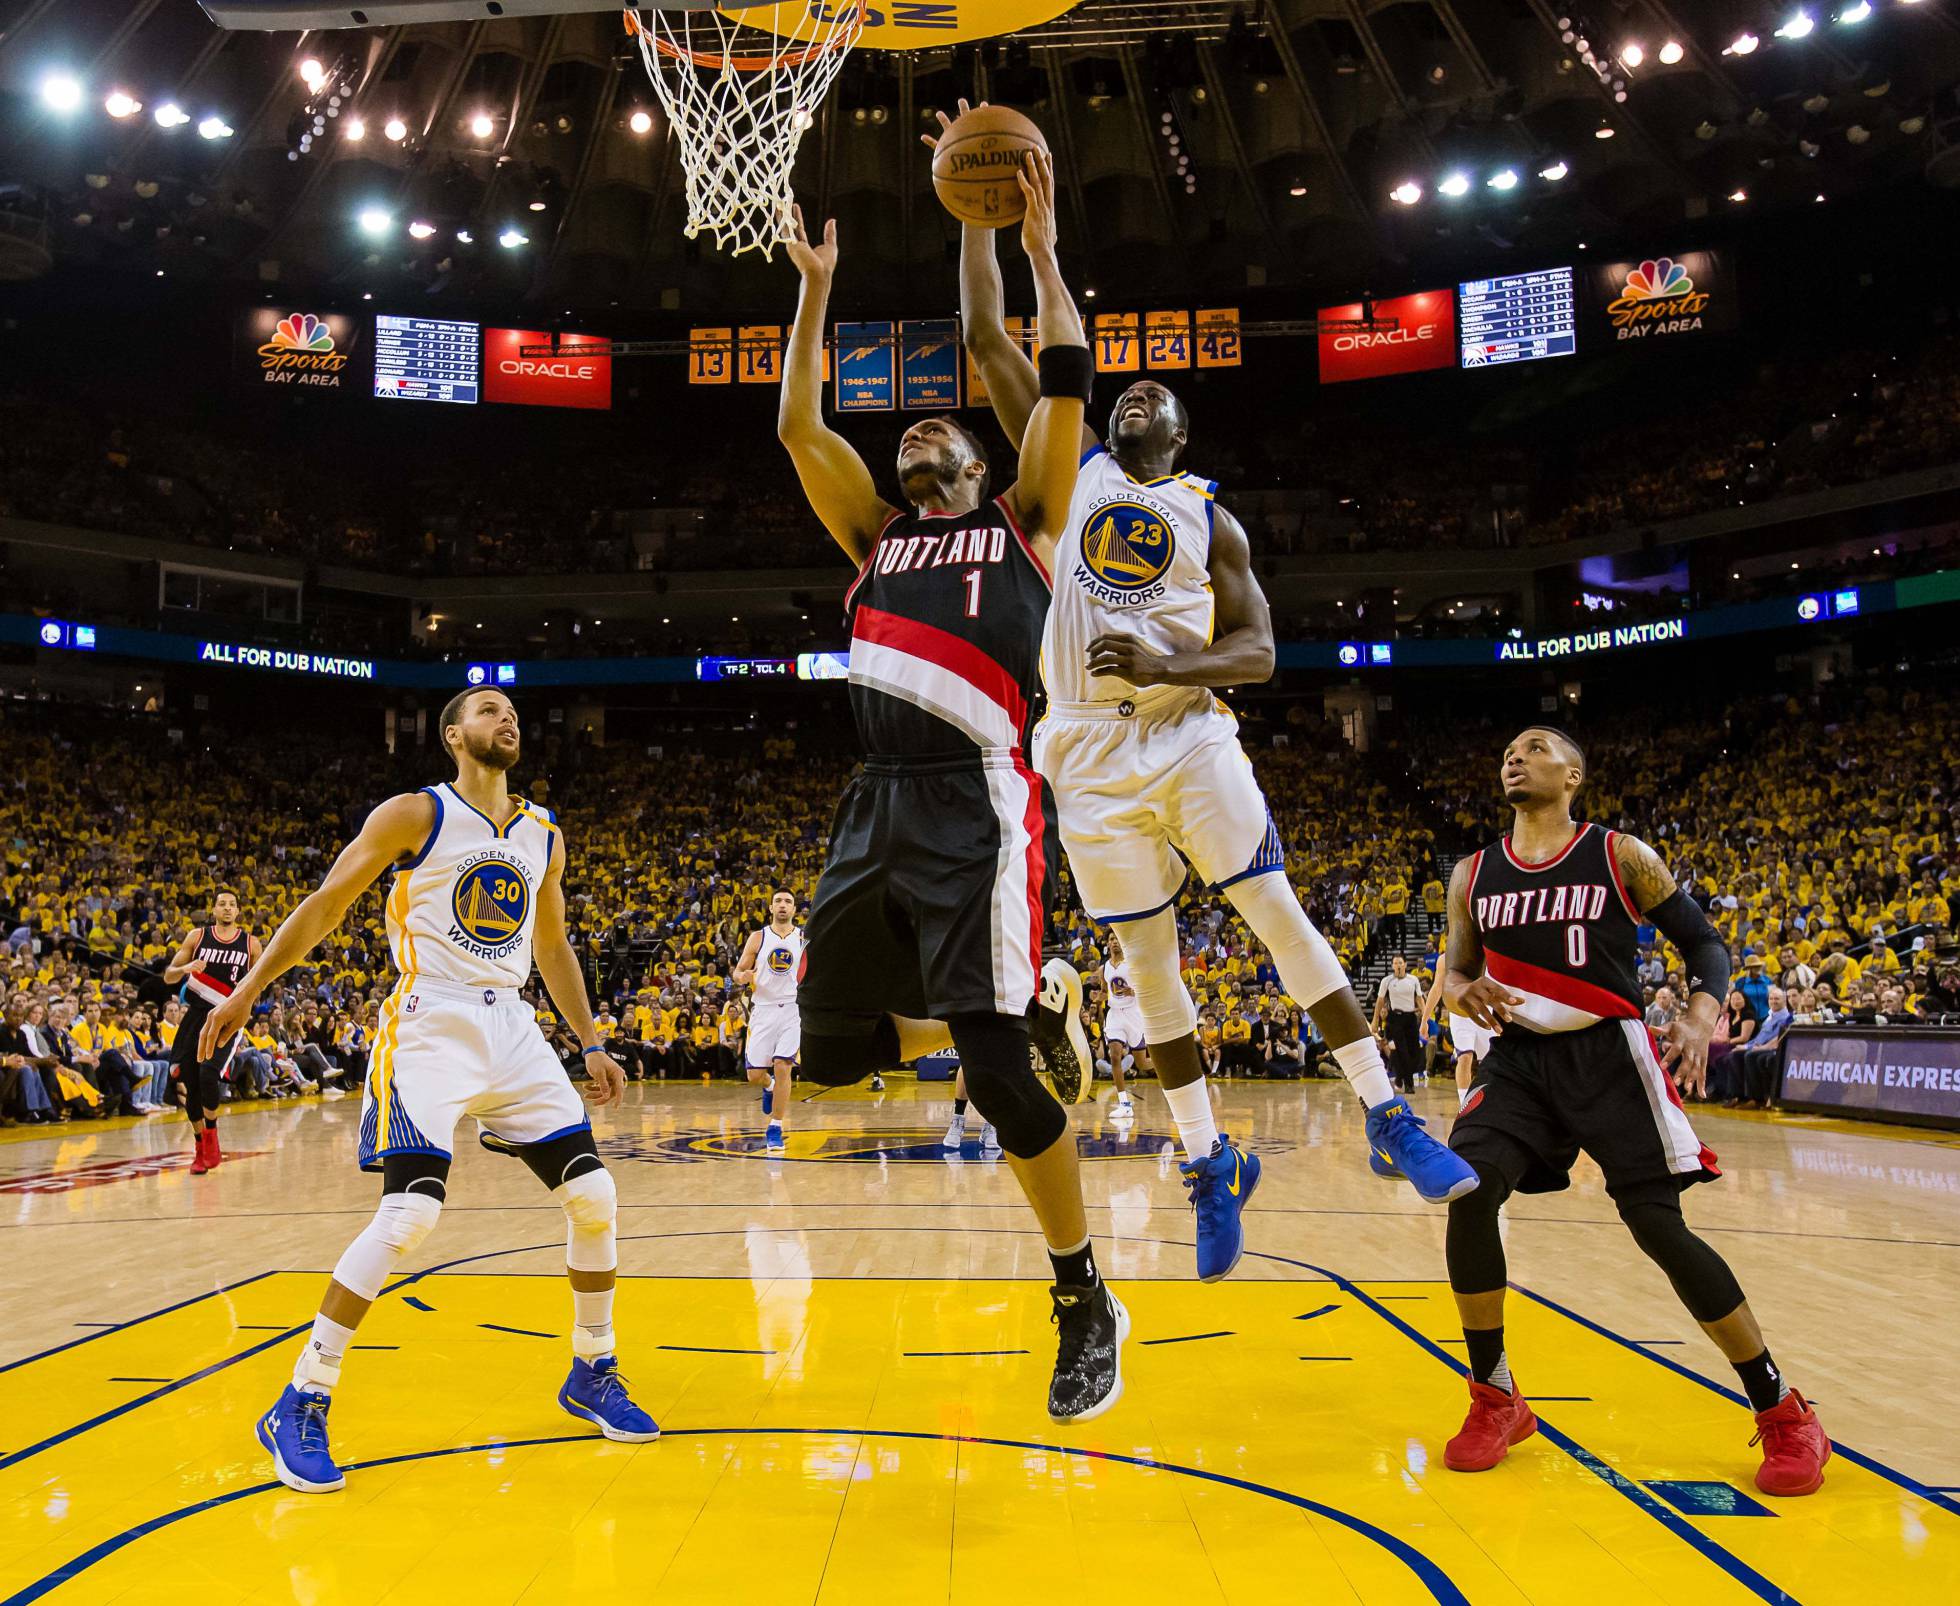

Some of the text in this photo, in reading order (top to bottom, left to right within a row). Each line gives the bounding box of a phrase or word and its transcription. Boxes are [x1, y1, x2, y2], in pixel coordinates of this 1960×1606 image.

[1607, 291, 1709, 328] Sports
[1334, 324, 1433, 351] ORACLE
[1617, 317, 1702, 340] BAY AREA
[257, 343, 347, 371] Sports
[1102, 335, 1131, 364] 17
[1150, 334, 1186, 362] 24
[1201, 331, 1238, 359] 42
[500, 360, 592, 379] ORACLE
[697, 347, 724, 377] 13
[746, 346, 774, 376] 14
[265, 371, 340, 387] BAY AREA
[843, 377, 888, 385] 1946-1947
[843, 399, 888, 407] CHAMPIONS
[1088, 493, 1145, 510] GOLDEN
[1128, 520, 1163, 546] 23
[874, 527, 1006, 580] PORTLAND
[963, 568, 983, 617] 1
[1073, 564, 1165, 605] WARRIORS
[1500, 619, 1682, 659] ALL FOR DUB NATION
[202, 643, 372, 678] ALL FOR DUB NATION
[456, 850, 535, 886] GOLDEN STATE
[493, 879, 520, 903] 30
[1477, 885, 1607, 933] PORTLAND
[447, 924, 523, 960] WARRIORS
[1567, 924, 1587, 966] 0
[199, 947, 248, 967] PORTLAND
[230, 965, 239, 982] 3
[1787, 1059, 1878, 1086] AMERICAN
